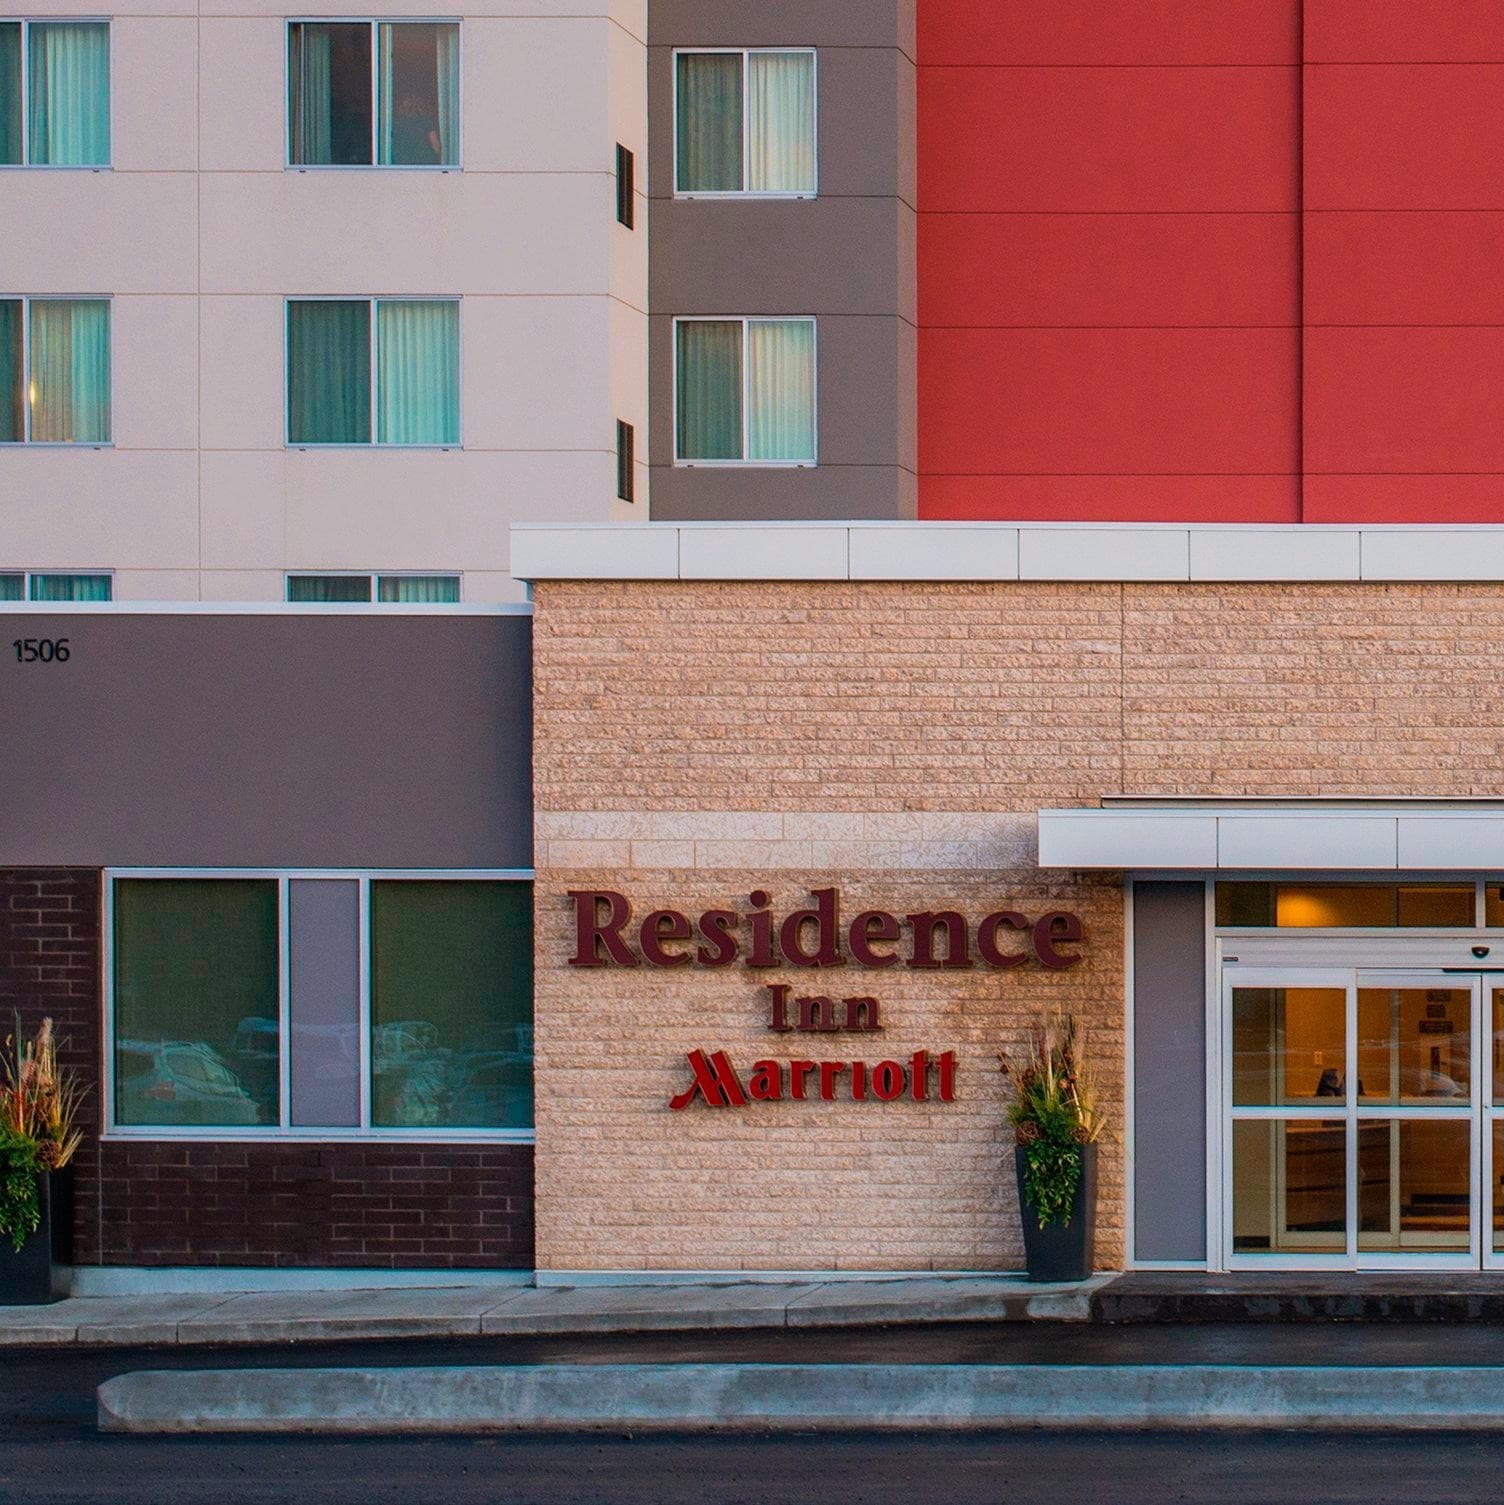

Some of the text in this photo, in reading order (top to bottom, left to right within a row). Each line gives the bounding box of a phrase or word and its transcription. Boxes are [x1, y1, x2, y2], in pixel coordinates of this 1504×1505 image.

[13, 638, 71, 663] 1506
[567, 887, 1084, 968] Residence
[766, 984, 884, 1032] Inn
[669, 1049, 959, 1110] Marriott
